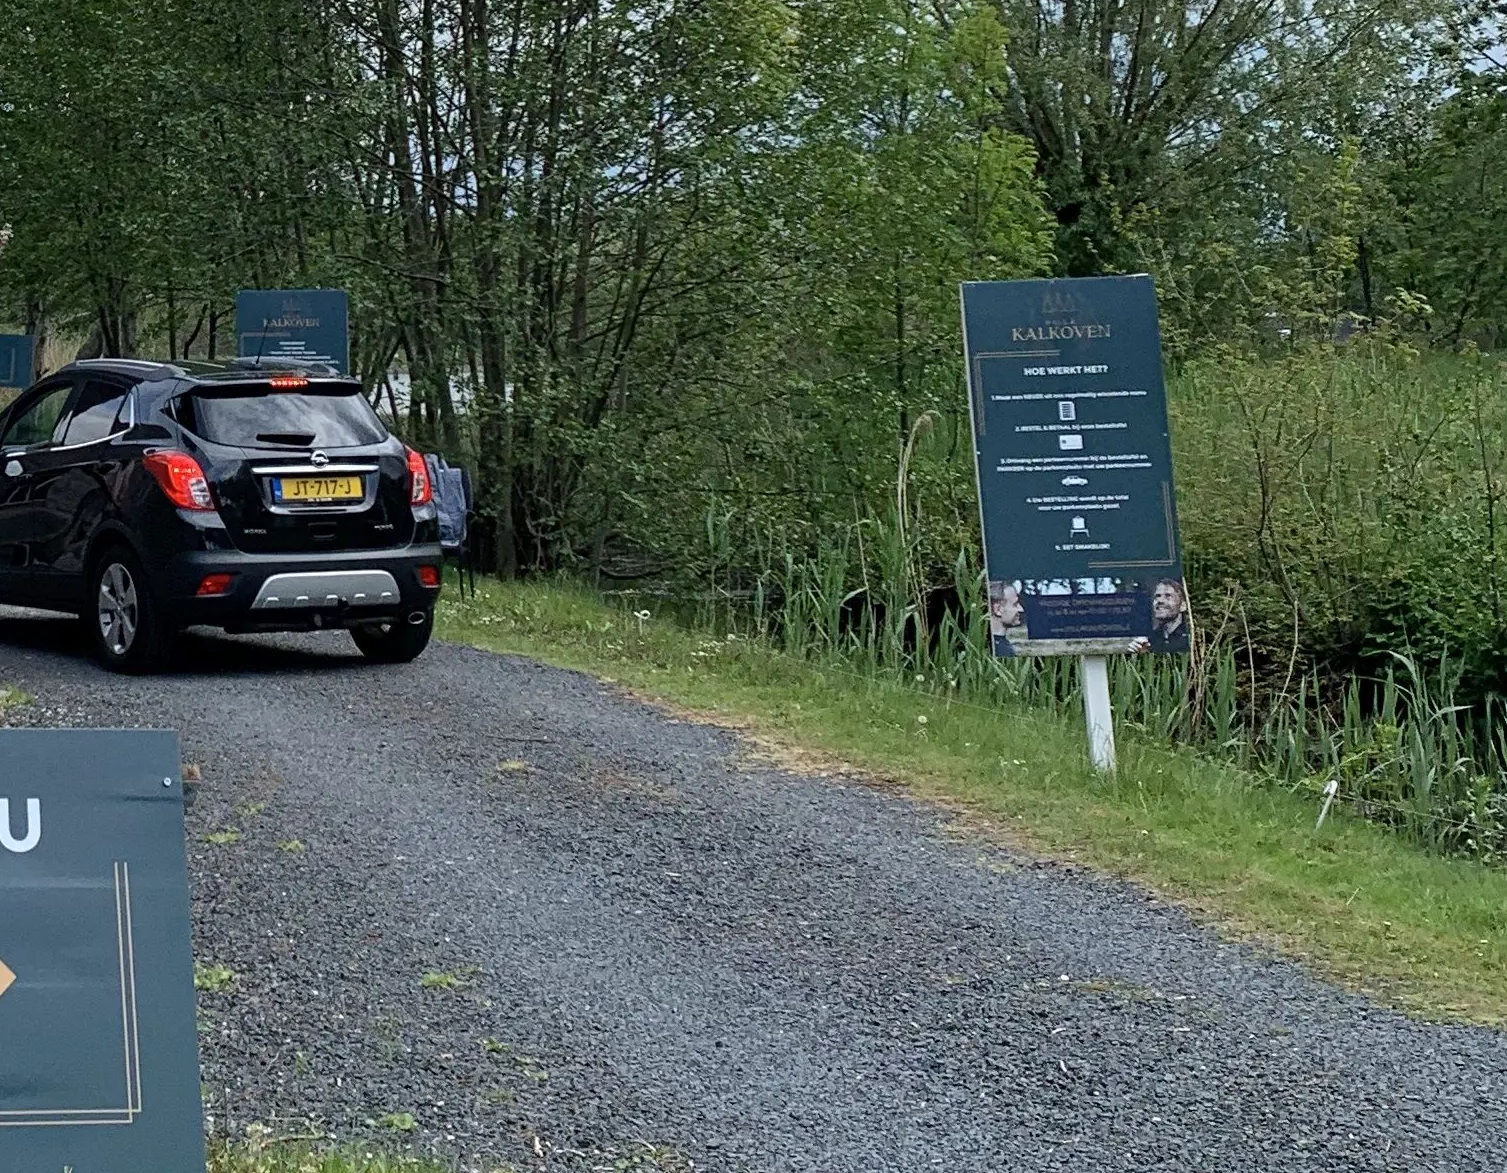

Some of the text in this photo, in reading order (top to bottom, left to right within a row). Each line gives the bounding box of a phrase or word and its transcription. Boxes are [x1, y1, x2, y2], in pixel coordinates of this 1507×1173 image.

[1011, 324, 1111, 342] KALKOVEN
[1023, 364, 1109, 376] HOE WERKT HET?
[293, 480, 352, 496] JT-717-J
